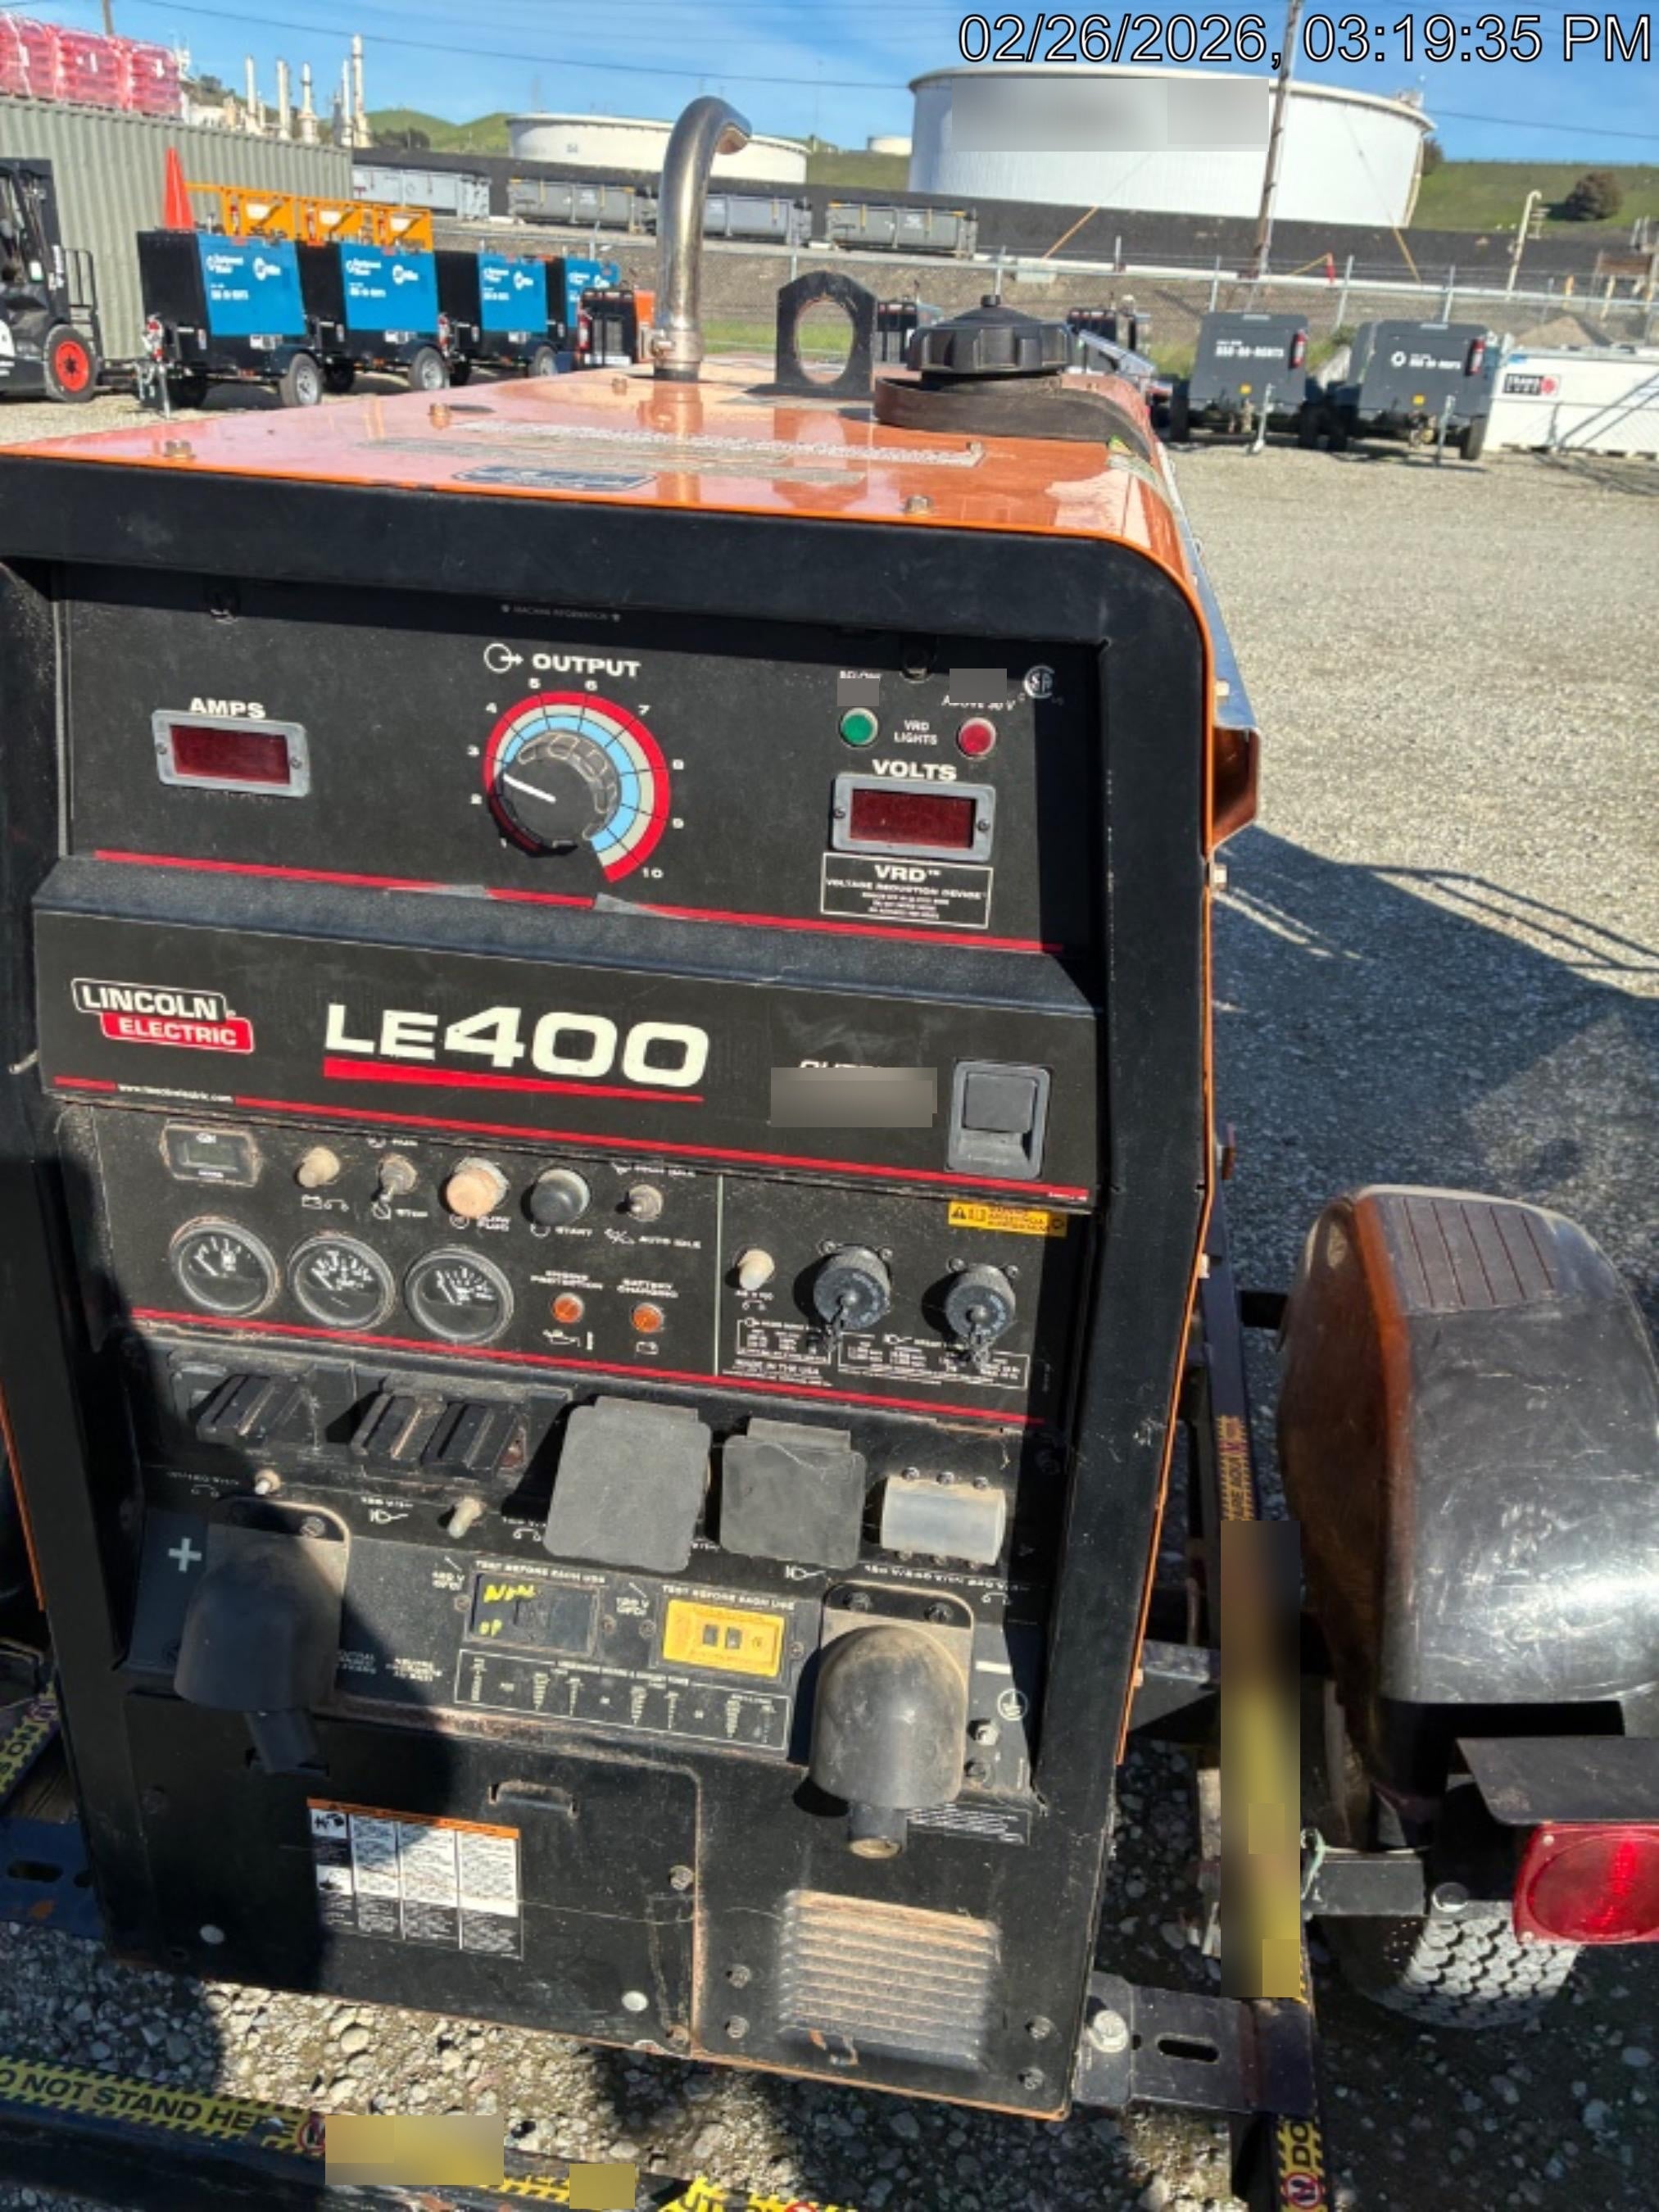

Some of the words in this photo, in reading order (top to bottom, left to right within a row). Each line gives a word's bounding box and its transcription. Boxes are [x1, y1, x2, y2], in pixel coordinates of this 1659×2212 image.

[533, 654, 641, 678] OUTPUT
[528, 678, 541, 689] 5
[585, 680, 597, 691] 6
[189, 697, 266, 719] AMPS
[486, 703, 497, 714] 4
[638, 705, 650, 715] 7
[904, 719, 930, 732] VRD
[894, 732, 938, 746] LIGHTS
[872, 759, 958, 781] VOLTS
[642, 868, 664, 879] 10
[83, 985, 218, 1022] LINCOLN
[118, 1018, 237, 1046] ELECTRIC
[325, 1004, 709, 1088] LE400
[21, 2074, 93, 2100] NOT
[93, 2087, 202, 2121] STAND
